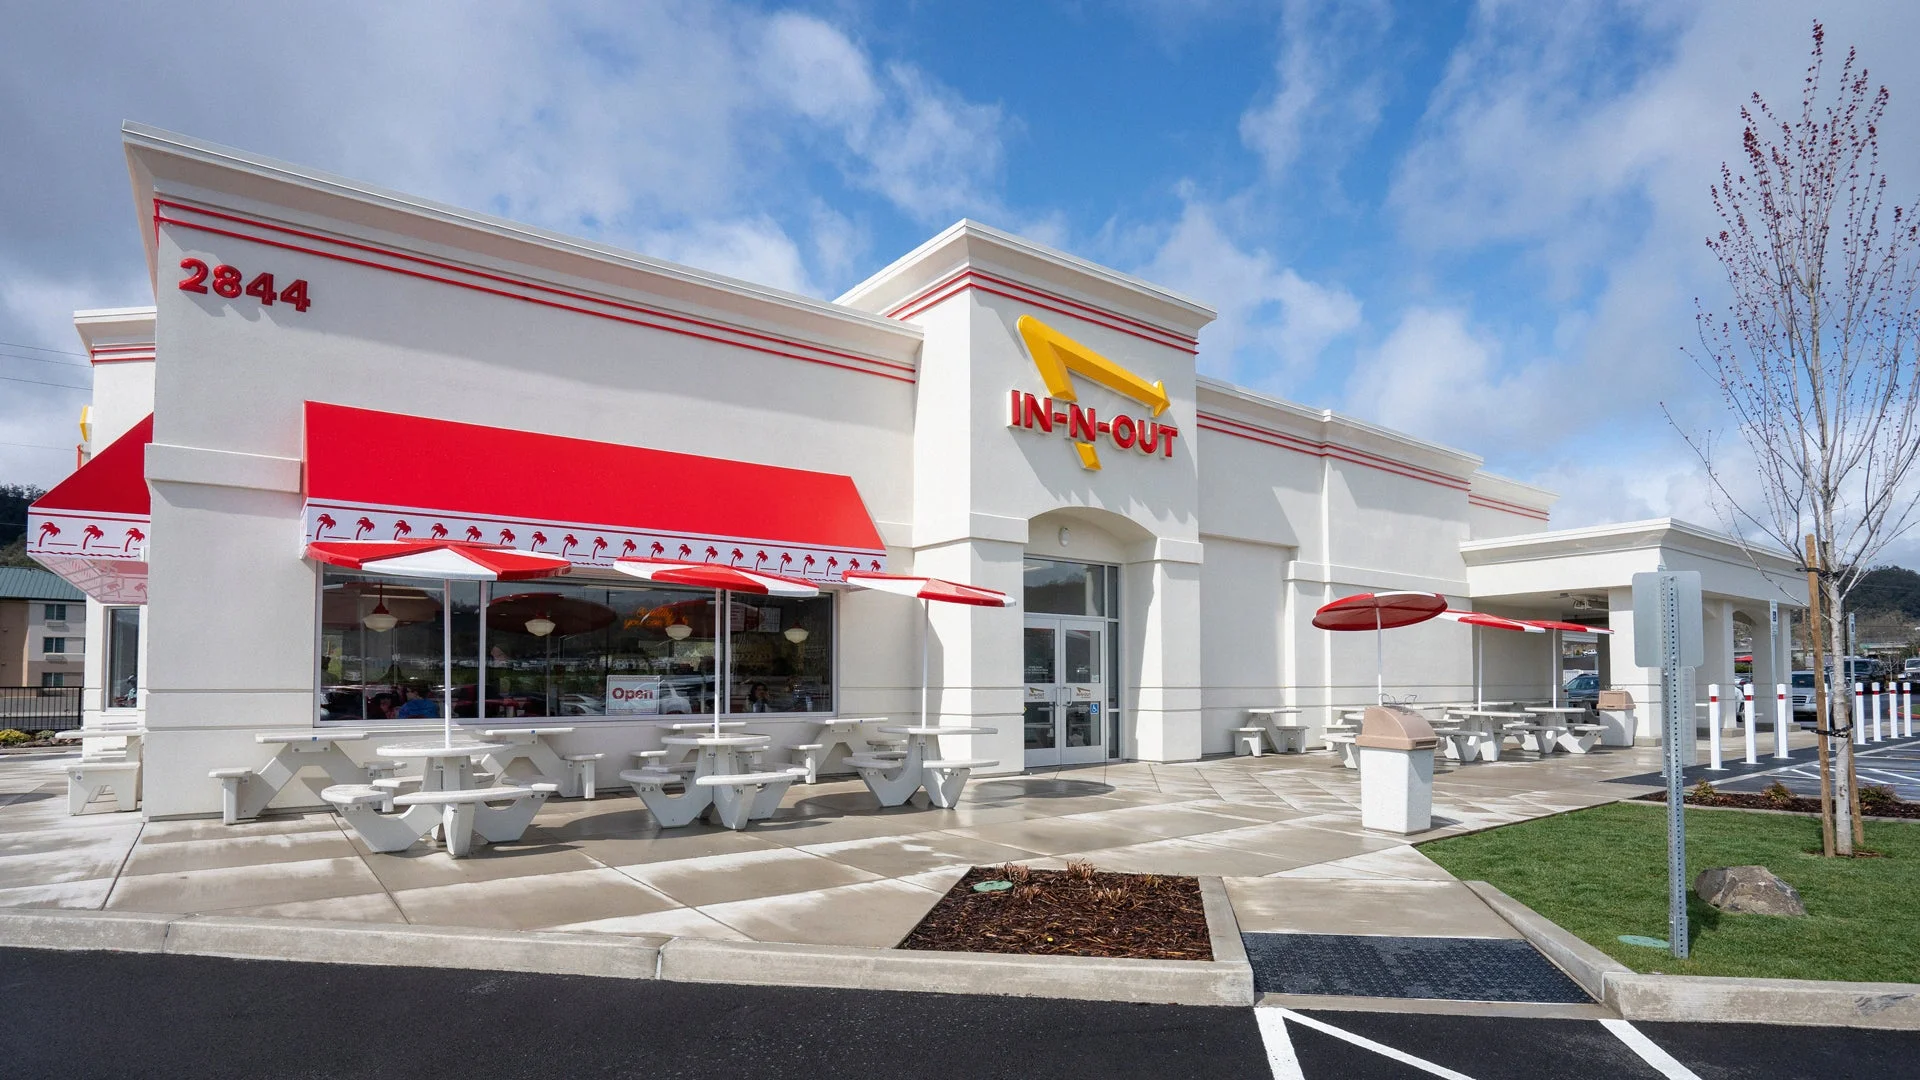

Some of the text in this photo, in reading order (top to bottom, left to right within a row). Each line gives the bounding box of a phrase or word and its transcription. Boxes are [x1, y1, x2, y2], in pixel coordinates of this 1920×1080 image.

[178, 257, 311, 313] 2844
[1008, 389, 1178, 458] IN-N-OUT
[612, 687, 654, 702] Open
